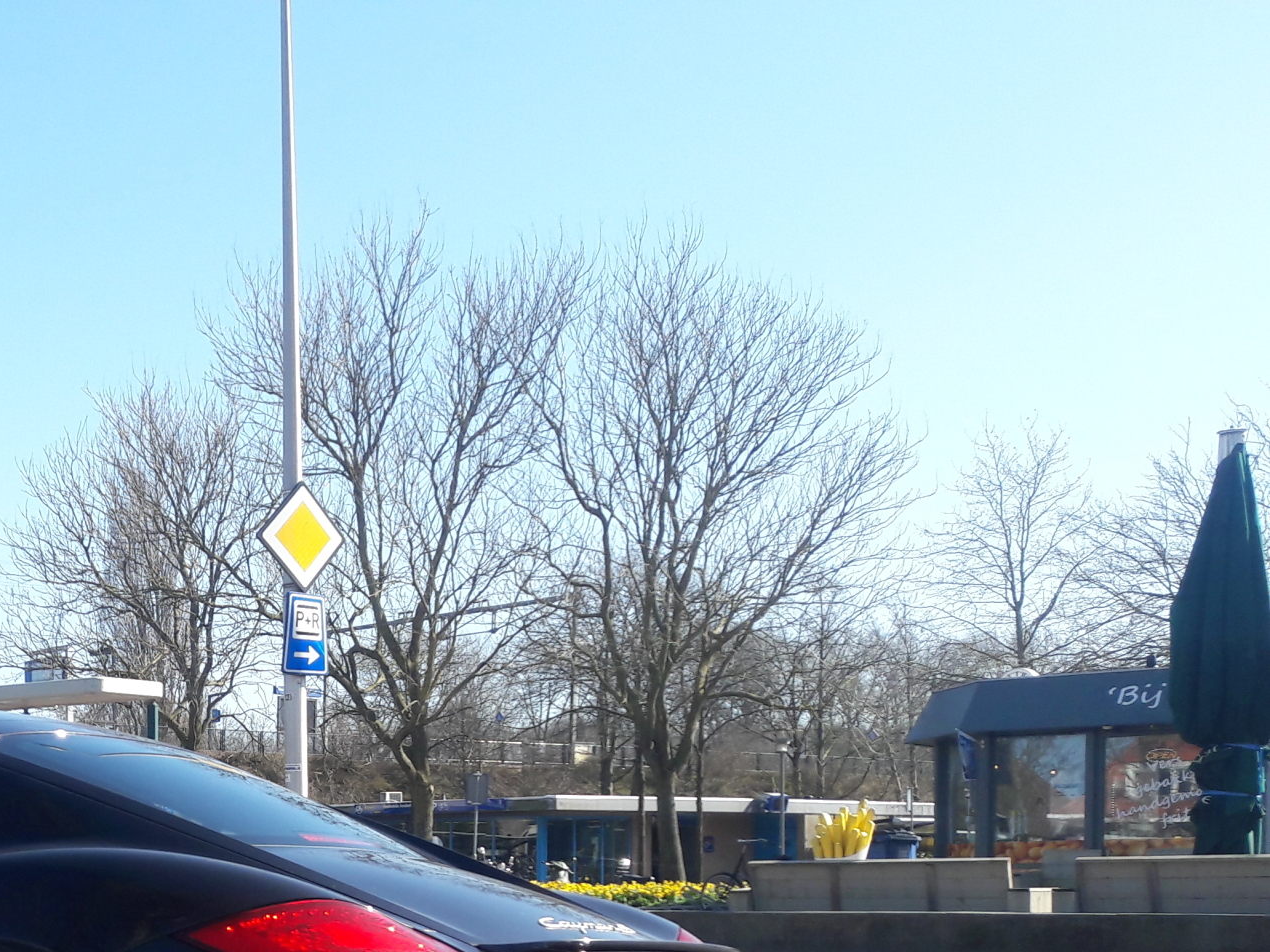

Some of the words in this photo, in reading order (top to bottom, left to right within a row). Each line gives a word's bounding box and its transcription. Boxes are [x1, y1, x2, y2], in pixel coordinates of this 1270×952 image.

[295, 610, 320, 629] P+R
[1135, 770, 1196, 799] gebakk
[1162, 807, 1191, 829] frit
[538, 916, 617, 935] Cayman
